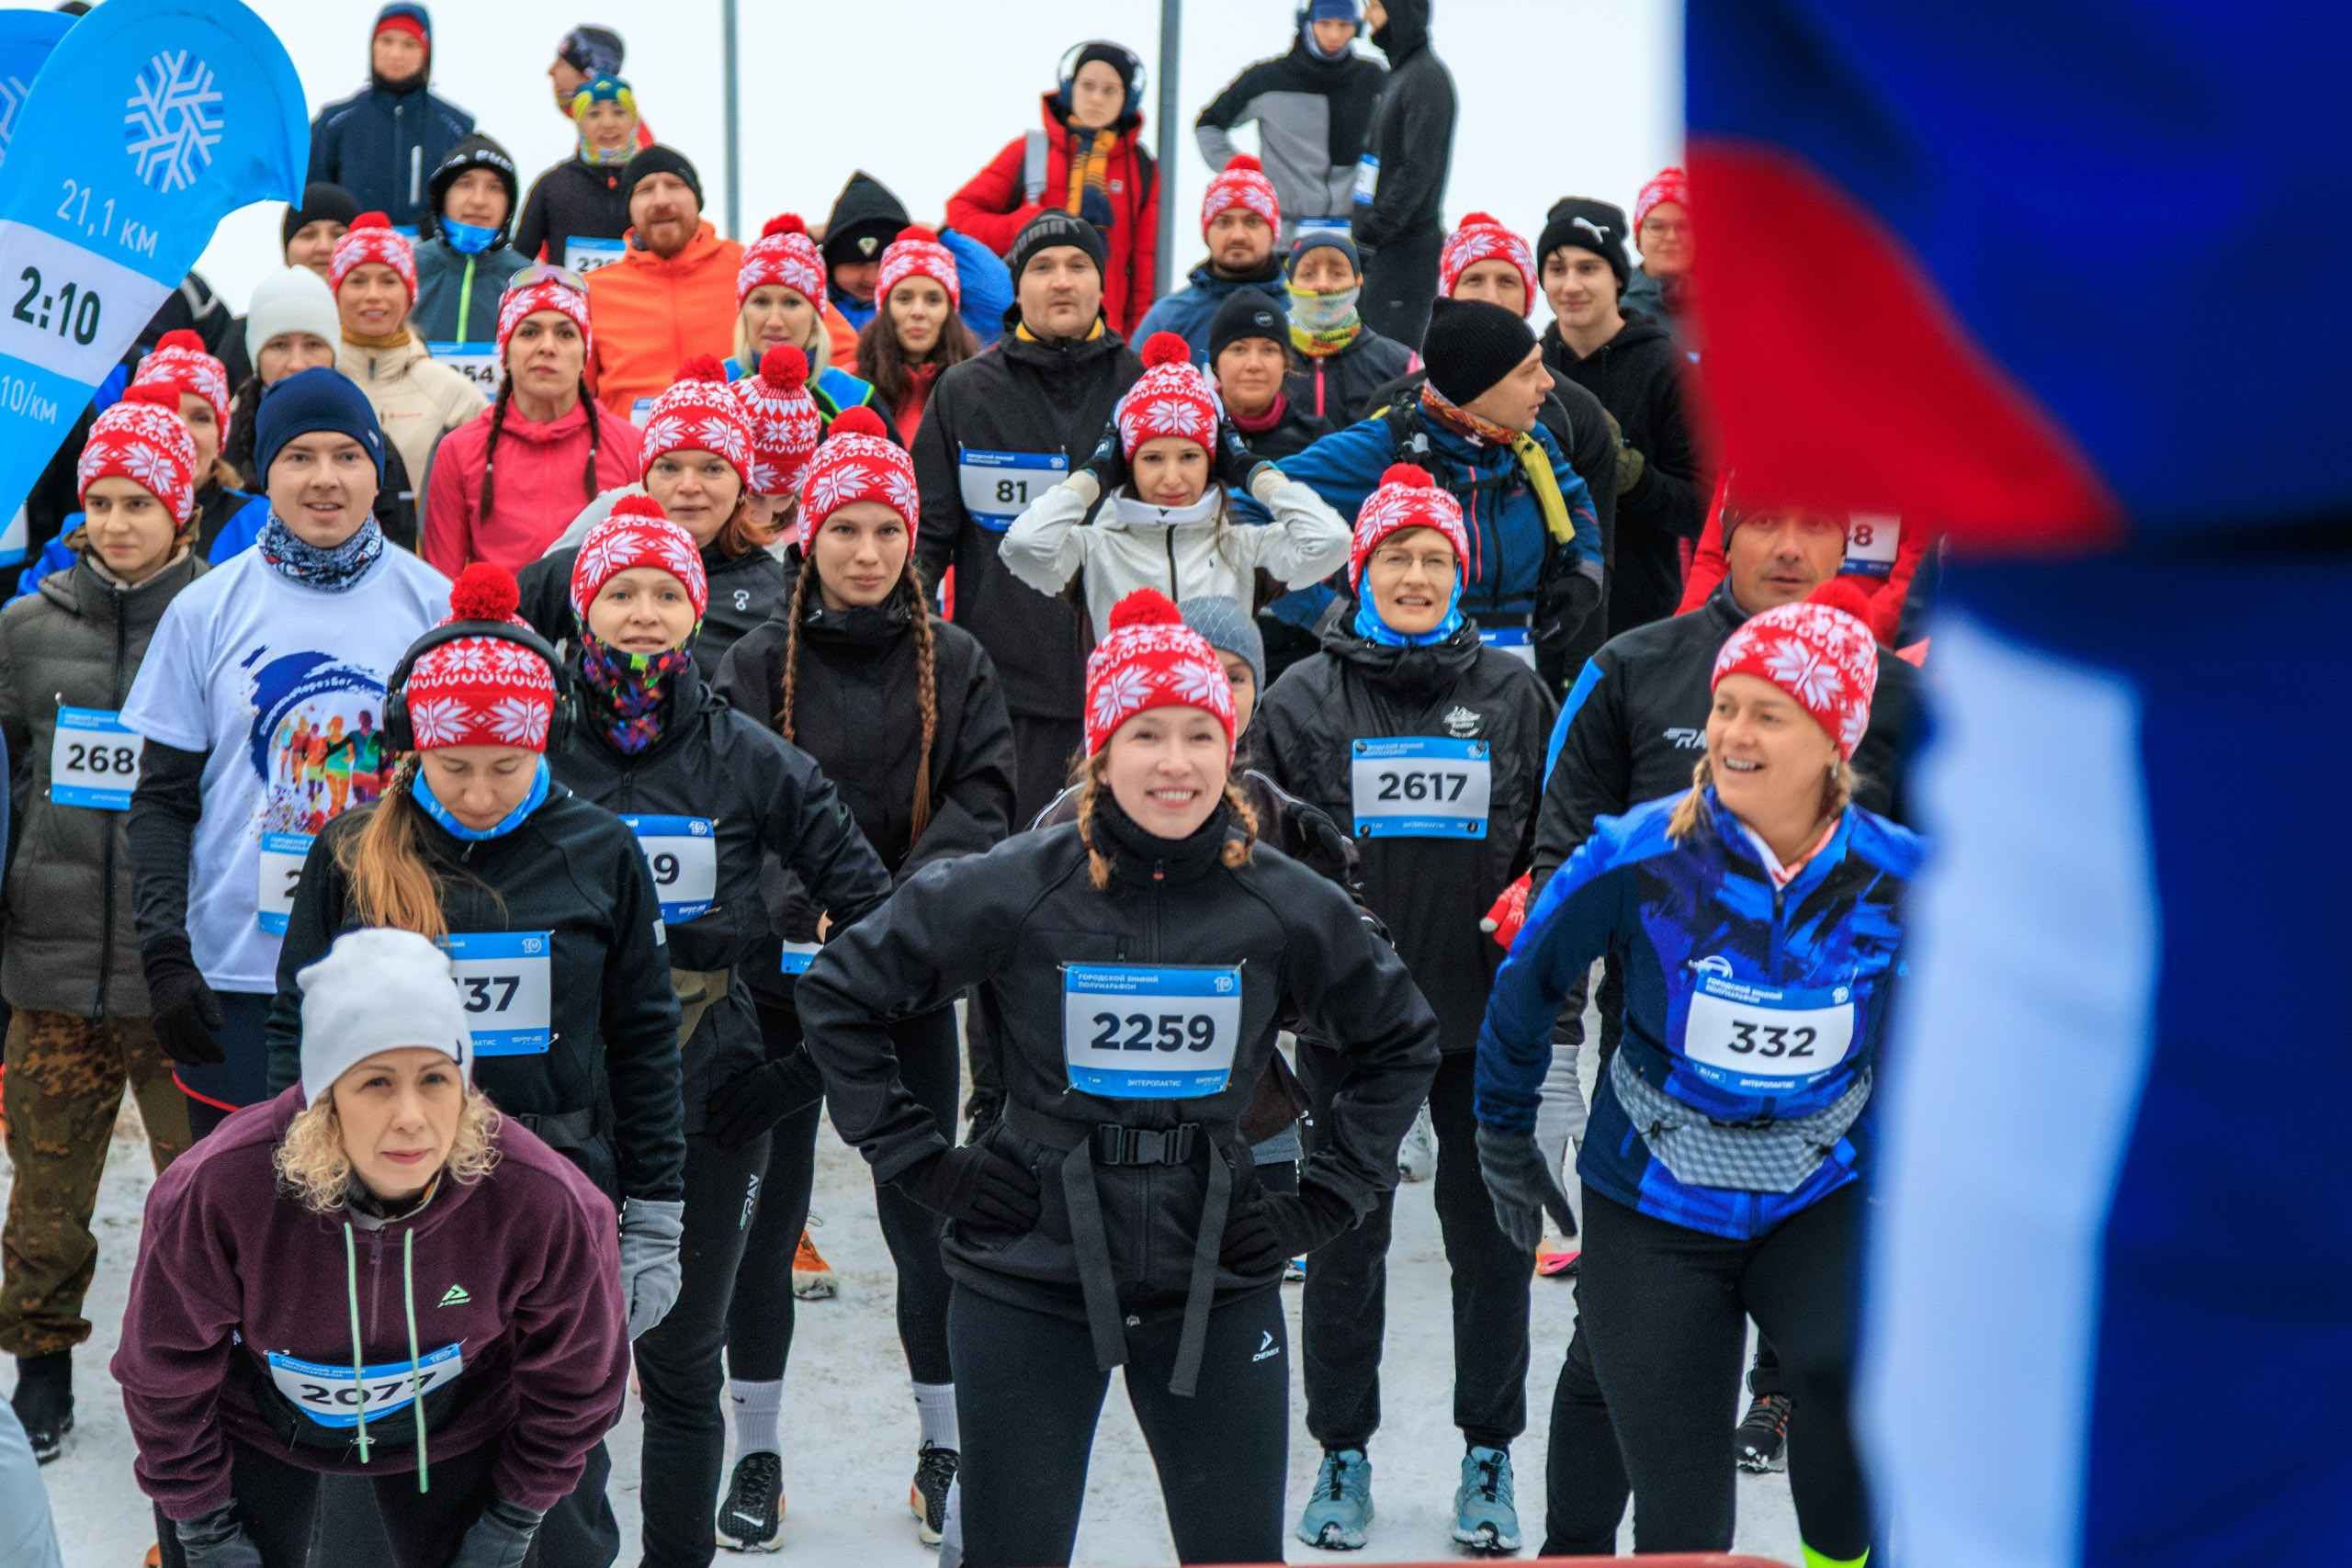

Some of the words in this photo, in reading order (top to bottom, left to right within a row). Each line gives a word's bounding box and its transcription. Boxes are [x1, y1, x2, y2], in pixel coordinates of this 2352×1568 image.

[56, 178, 115, 237] 21,1
[12, 265, 101, 345] 2:10
[996, 479, 1027, 504] 81
[66, 743, 134, 773] 268
[1377, 771, 1469, 803] 2617
[452, 976, 521, 1014] 37
[471, 1038, 497, 1047] АКТИС
[1090, 1011, 1216, 1054] 2259
[1727, 1019, 1817, 1058] 332
[300, 1371, 437, 1406] 2077
